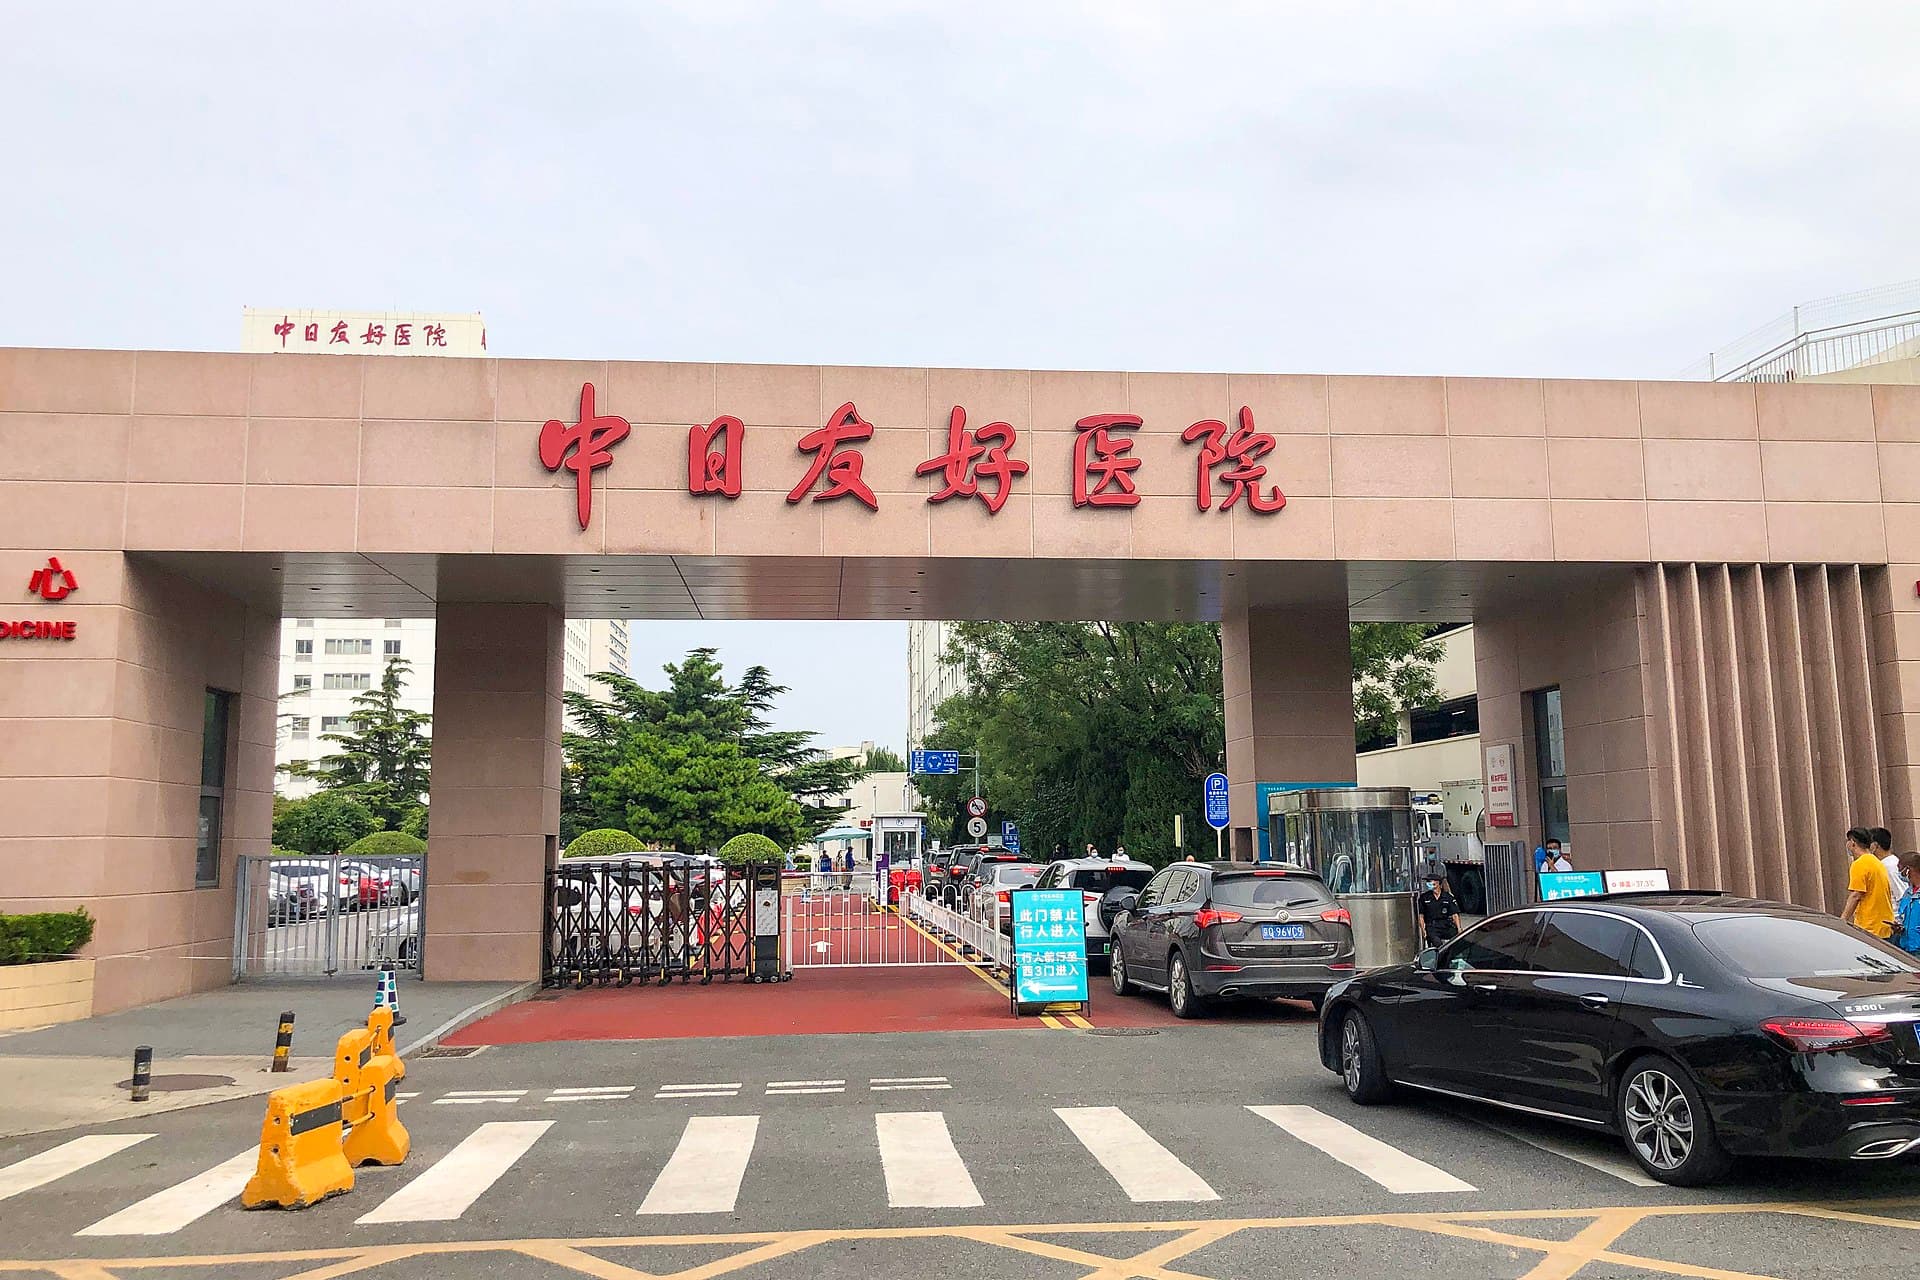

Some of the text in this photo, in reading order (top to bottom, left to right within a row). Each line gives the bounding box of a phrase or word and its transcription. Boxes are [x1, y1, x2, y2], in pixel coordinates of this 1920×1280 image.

[274, 315, 448, 348] 中日友好医院
[538, 382, 1287, 531] 中日友好医院
[973, 821, 981, 833] 5
[1005, 822, 1016, 834] P
[1020, 908, 1078, 922] 此门禁止
[1021, 924, 1079, 938] 行人进入
[1021, 951, 1078, 963] 行人前行至
[1022, 964, 1080, 977] 西3门进入
